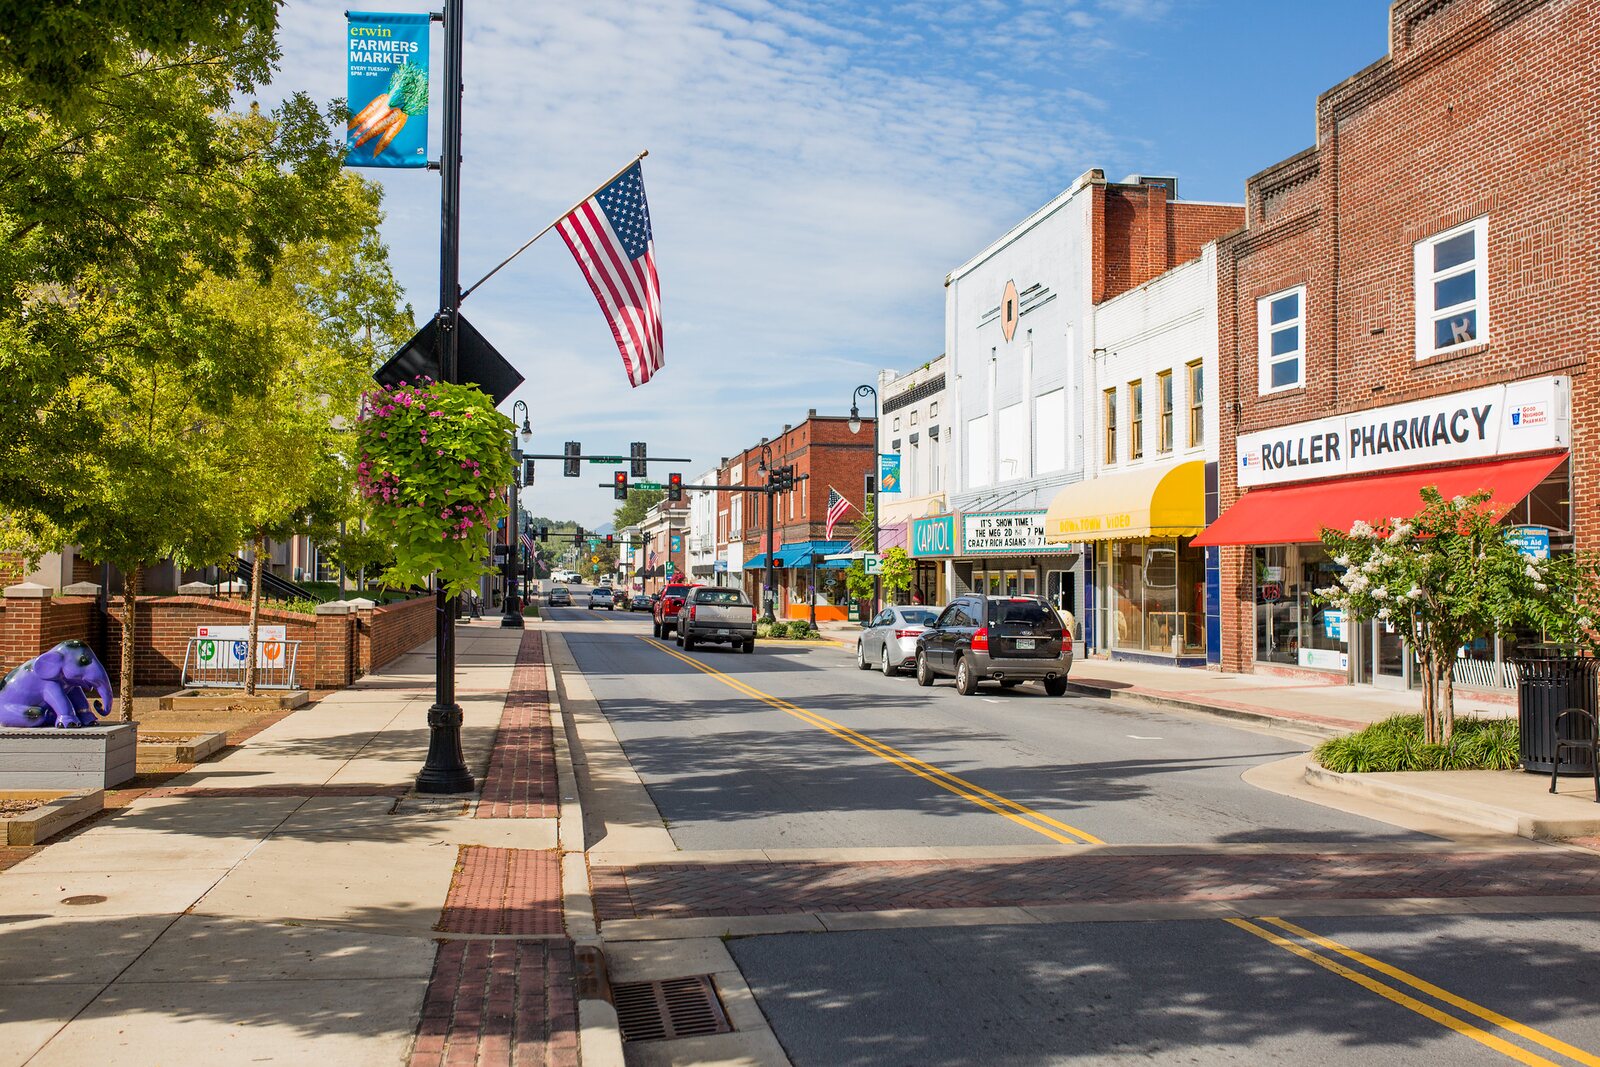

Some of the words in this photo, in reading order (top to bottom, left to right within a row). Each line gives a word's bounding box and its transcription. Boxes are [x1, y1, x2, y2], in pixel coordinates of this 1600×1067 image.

[350, 24, 392, 37] erwin
[350, 39, 418, 52] FARMERS
[350, 51, 409, 65] MARKET
[1262, 432, 1340, 470] ROLLER
[1350, 404, 1492, 458] PHARMACY
[980, 519, 992, 527] IT'S
[996, 518, 1012, 527] SHOW
[1106, 514, 1130, 529] VIDEO
[918, 521, 949, 551] CAPITOL
[976, 529, 986, 537] THE
[1034, 527, 1044, 535] PM
[968, 539, 988, 547] CRAZY
[1005, 538, 1026, 546] ASIANS
[1038, 537, 1042, 546] 7
[867, 559, 877, 571] P
